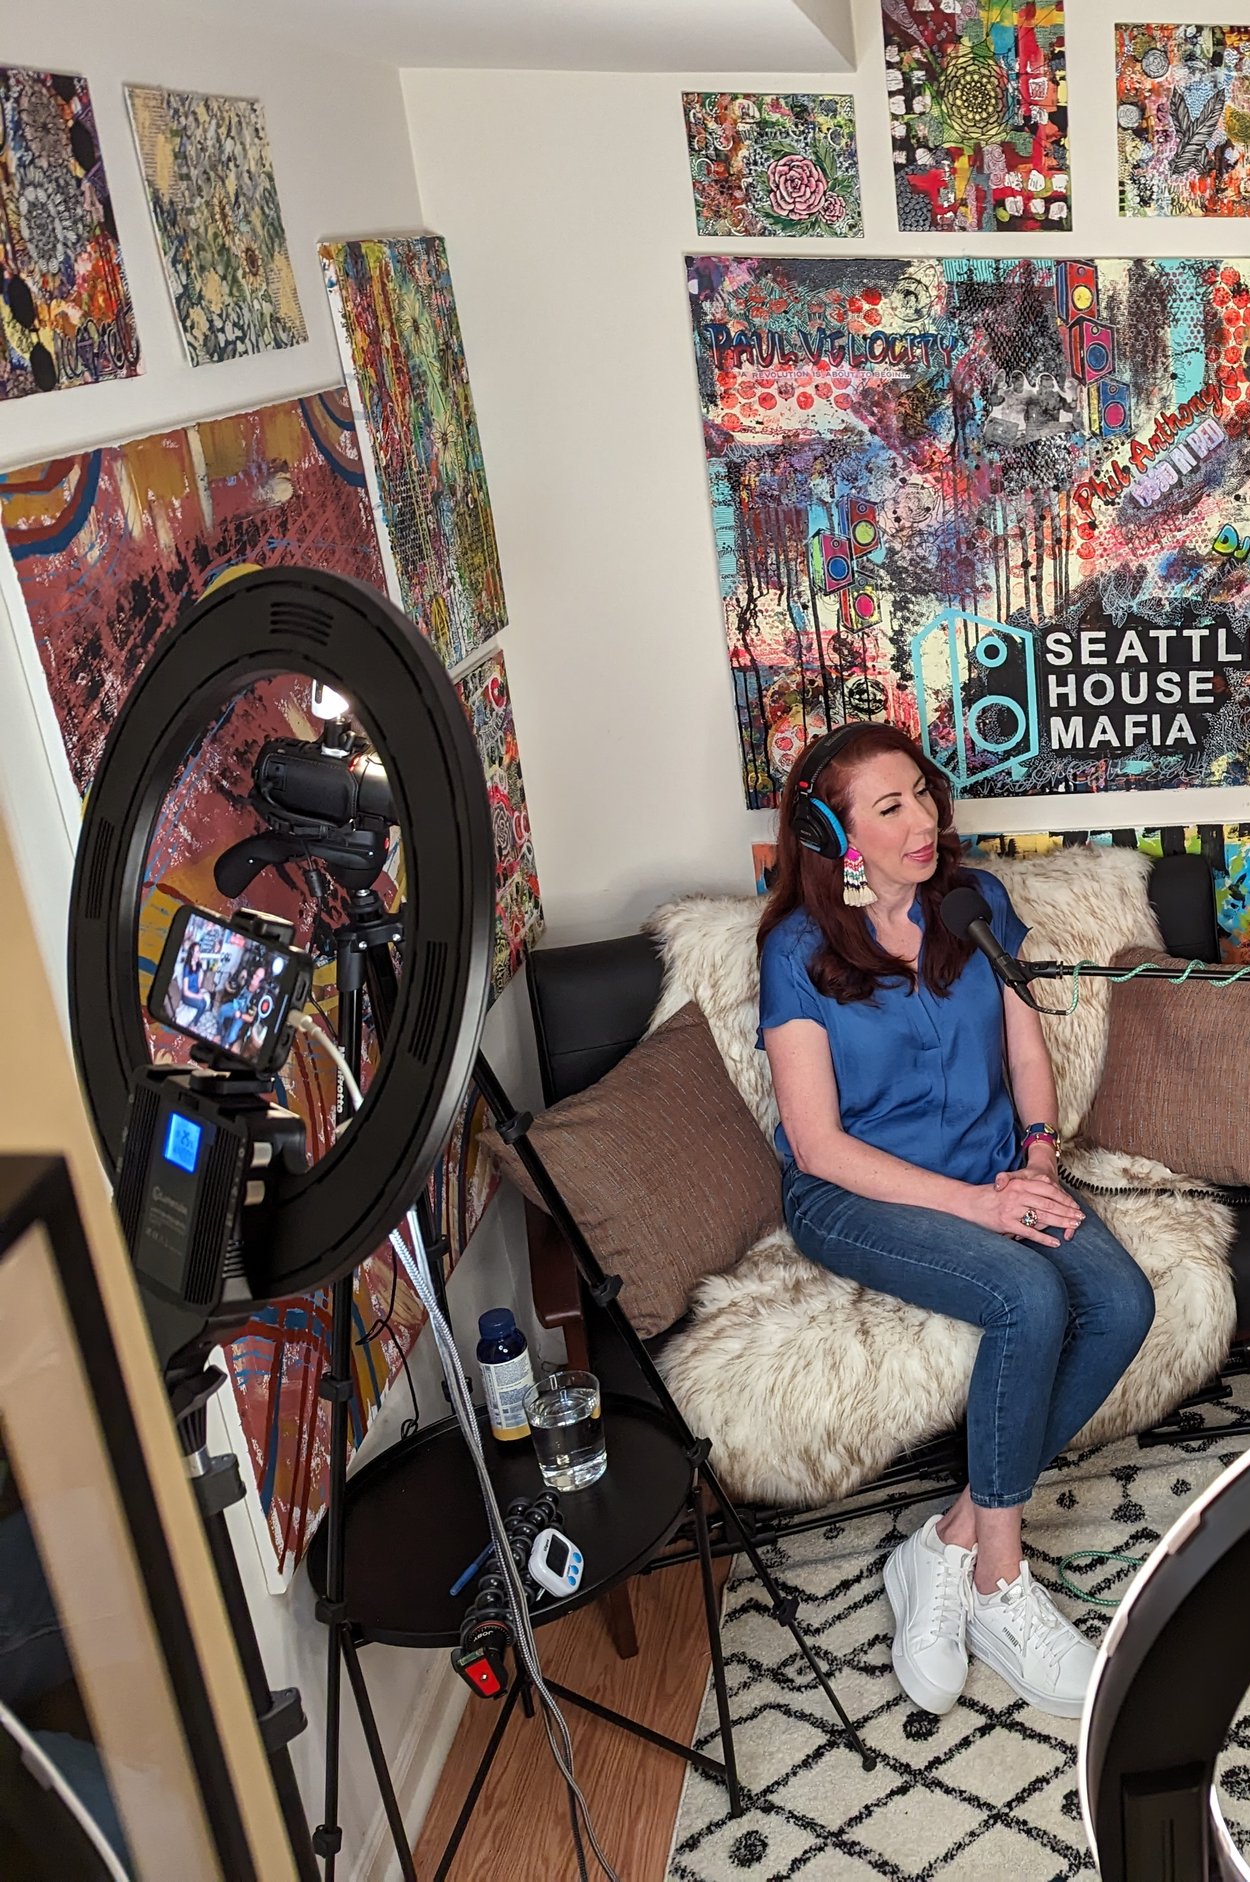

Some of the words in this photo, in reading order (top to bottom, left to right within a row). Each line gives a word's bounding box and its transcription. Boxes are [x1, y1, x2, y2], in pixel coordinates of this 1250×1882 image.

[704, 323, 799, 370] PAUL
[799, 325, 957, 370] VELOCITY
[752, 371, 809, 379] REVOLUTION
[860, 371, 873, 379] TO
[1073, 460, 1131, 522] Phil
[1129, 383, 1223, 474] Anthony
[1047, 670, 1215, 707] HOUSE
[1050, 712, 1198, 750] MAFIA
[473, 1630, 494, 1642] JOBY
